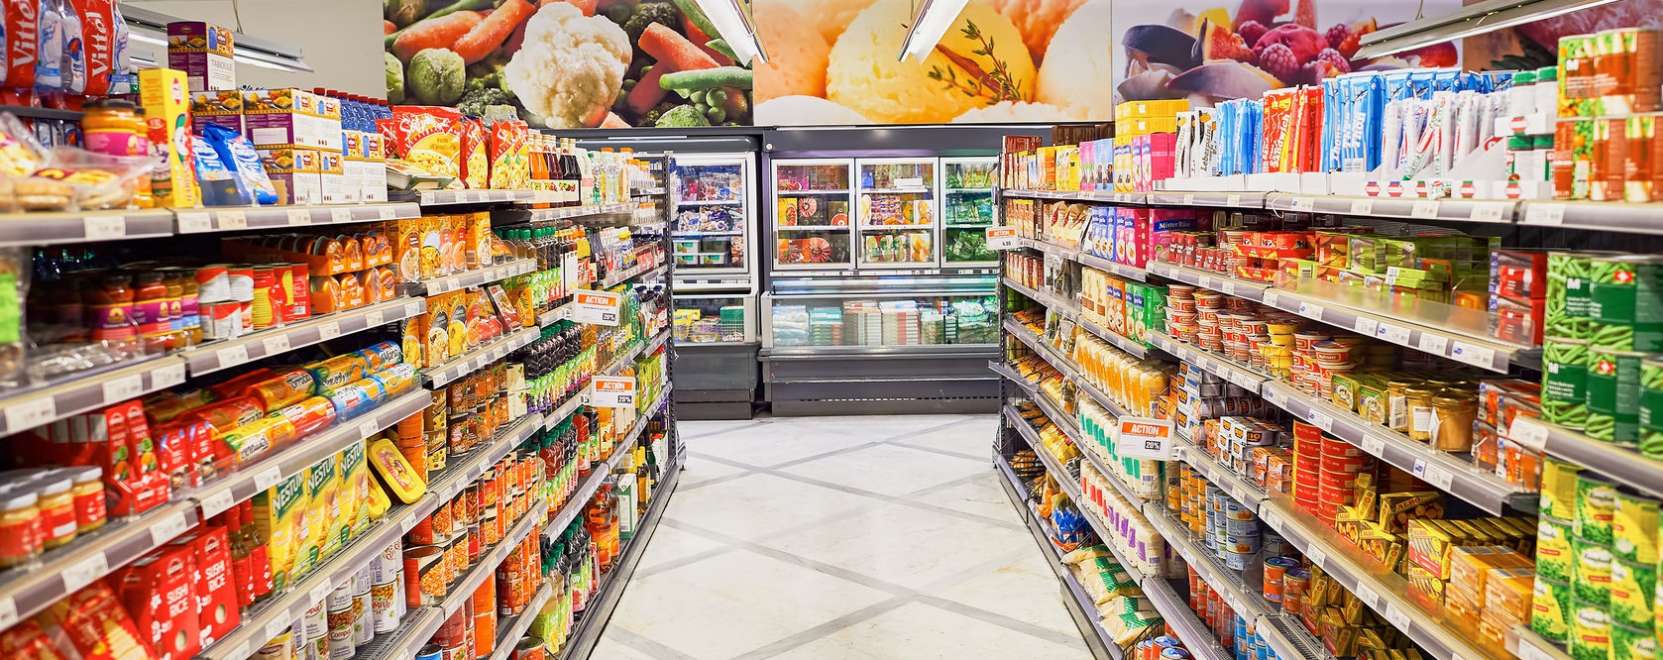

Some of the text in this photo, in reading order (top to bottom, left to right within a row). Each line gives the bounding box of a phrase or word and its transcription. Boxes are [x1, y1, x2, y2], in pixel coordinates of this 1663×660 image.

[12, 0, 36, 67] Vitte
[85, 12, 108, 77] Vittel
[1131, 423, 1160, 436] ACTION
